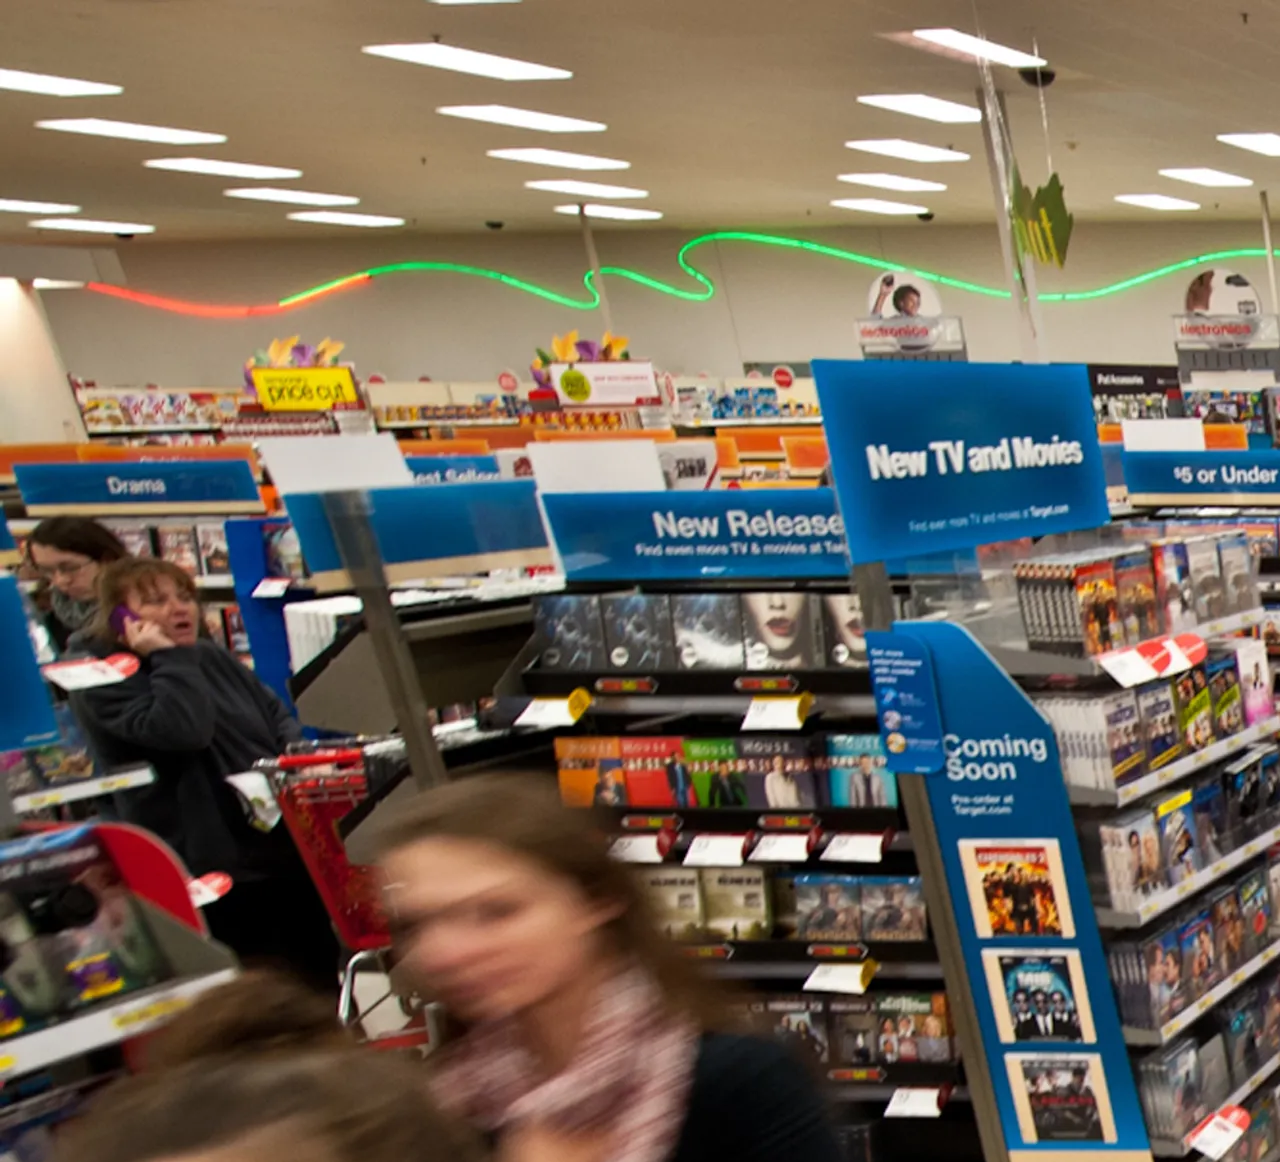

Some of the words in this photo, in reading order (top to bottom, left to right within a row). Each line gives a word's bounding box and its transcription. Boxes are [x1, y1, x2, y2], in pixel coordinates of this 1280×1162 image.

[267, 376, 313, 406] price
[315, 379, 346, 401] cut
[866, 443, 928, 481] New
[927, 440, 965, 475] TV
[967, 438, 1012, 473] and
[1011, 434, 1084, 469] Movies
[106, 476, 166, 496] Drama
[1197, 468, 1216, 484] or
[1221, 465, 1278, 484] Under
[652, 510, 719, 539] New
[725, 508, 846, 537] Release
[943, 732, 1048, 762] Coming
[946, 757, 1017, 781] Soon
[951, 793, 1002, 806] Pre-order
[1003, 794, 1014, 805] at
[953, 804, 1013, 817] Target.com
